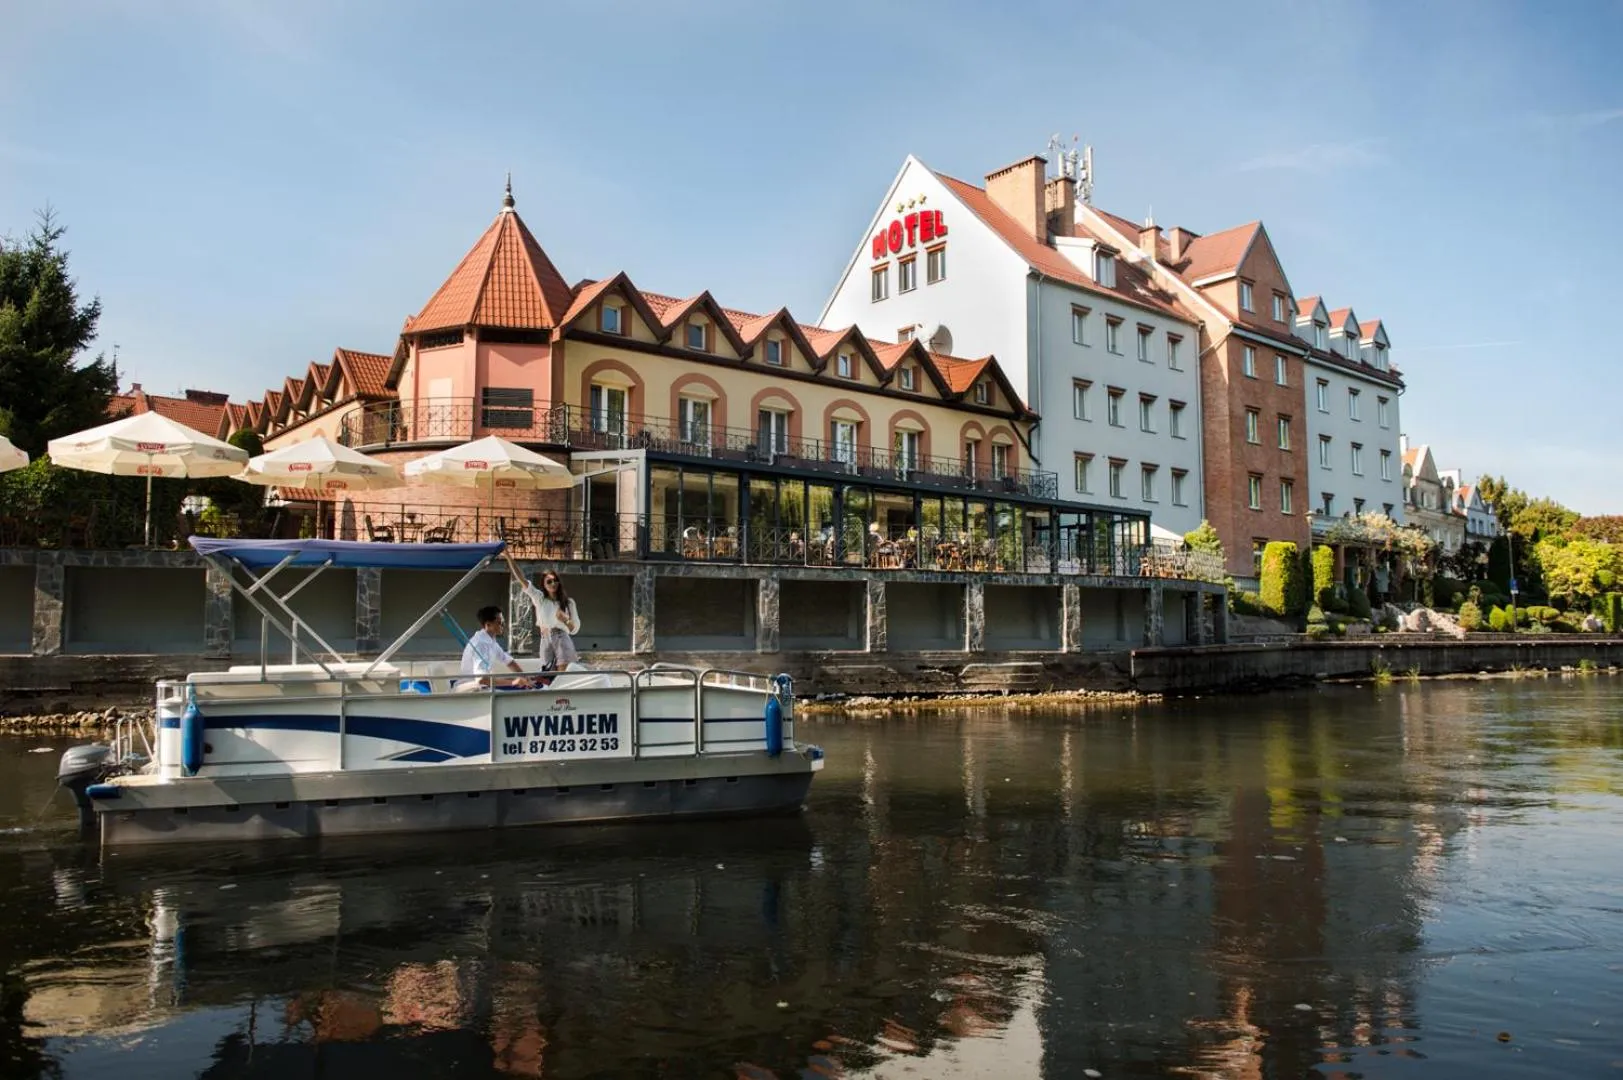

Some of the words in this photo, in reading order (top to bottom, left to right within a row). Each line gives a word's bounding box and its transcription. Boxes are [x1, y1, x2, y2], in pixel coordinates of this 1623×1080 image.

[872, 210, 948, 260] HOTEL
[504, 713, 618, 738] WYNAJEM
[503, 741, 526, 755] tel.
[529, 740, 546, 754] 87
[548, 739, 576, 753] 423
[579, 738, 599, 752] 32
[600, 737, 619, 751] 53
